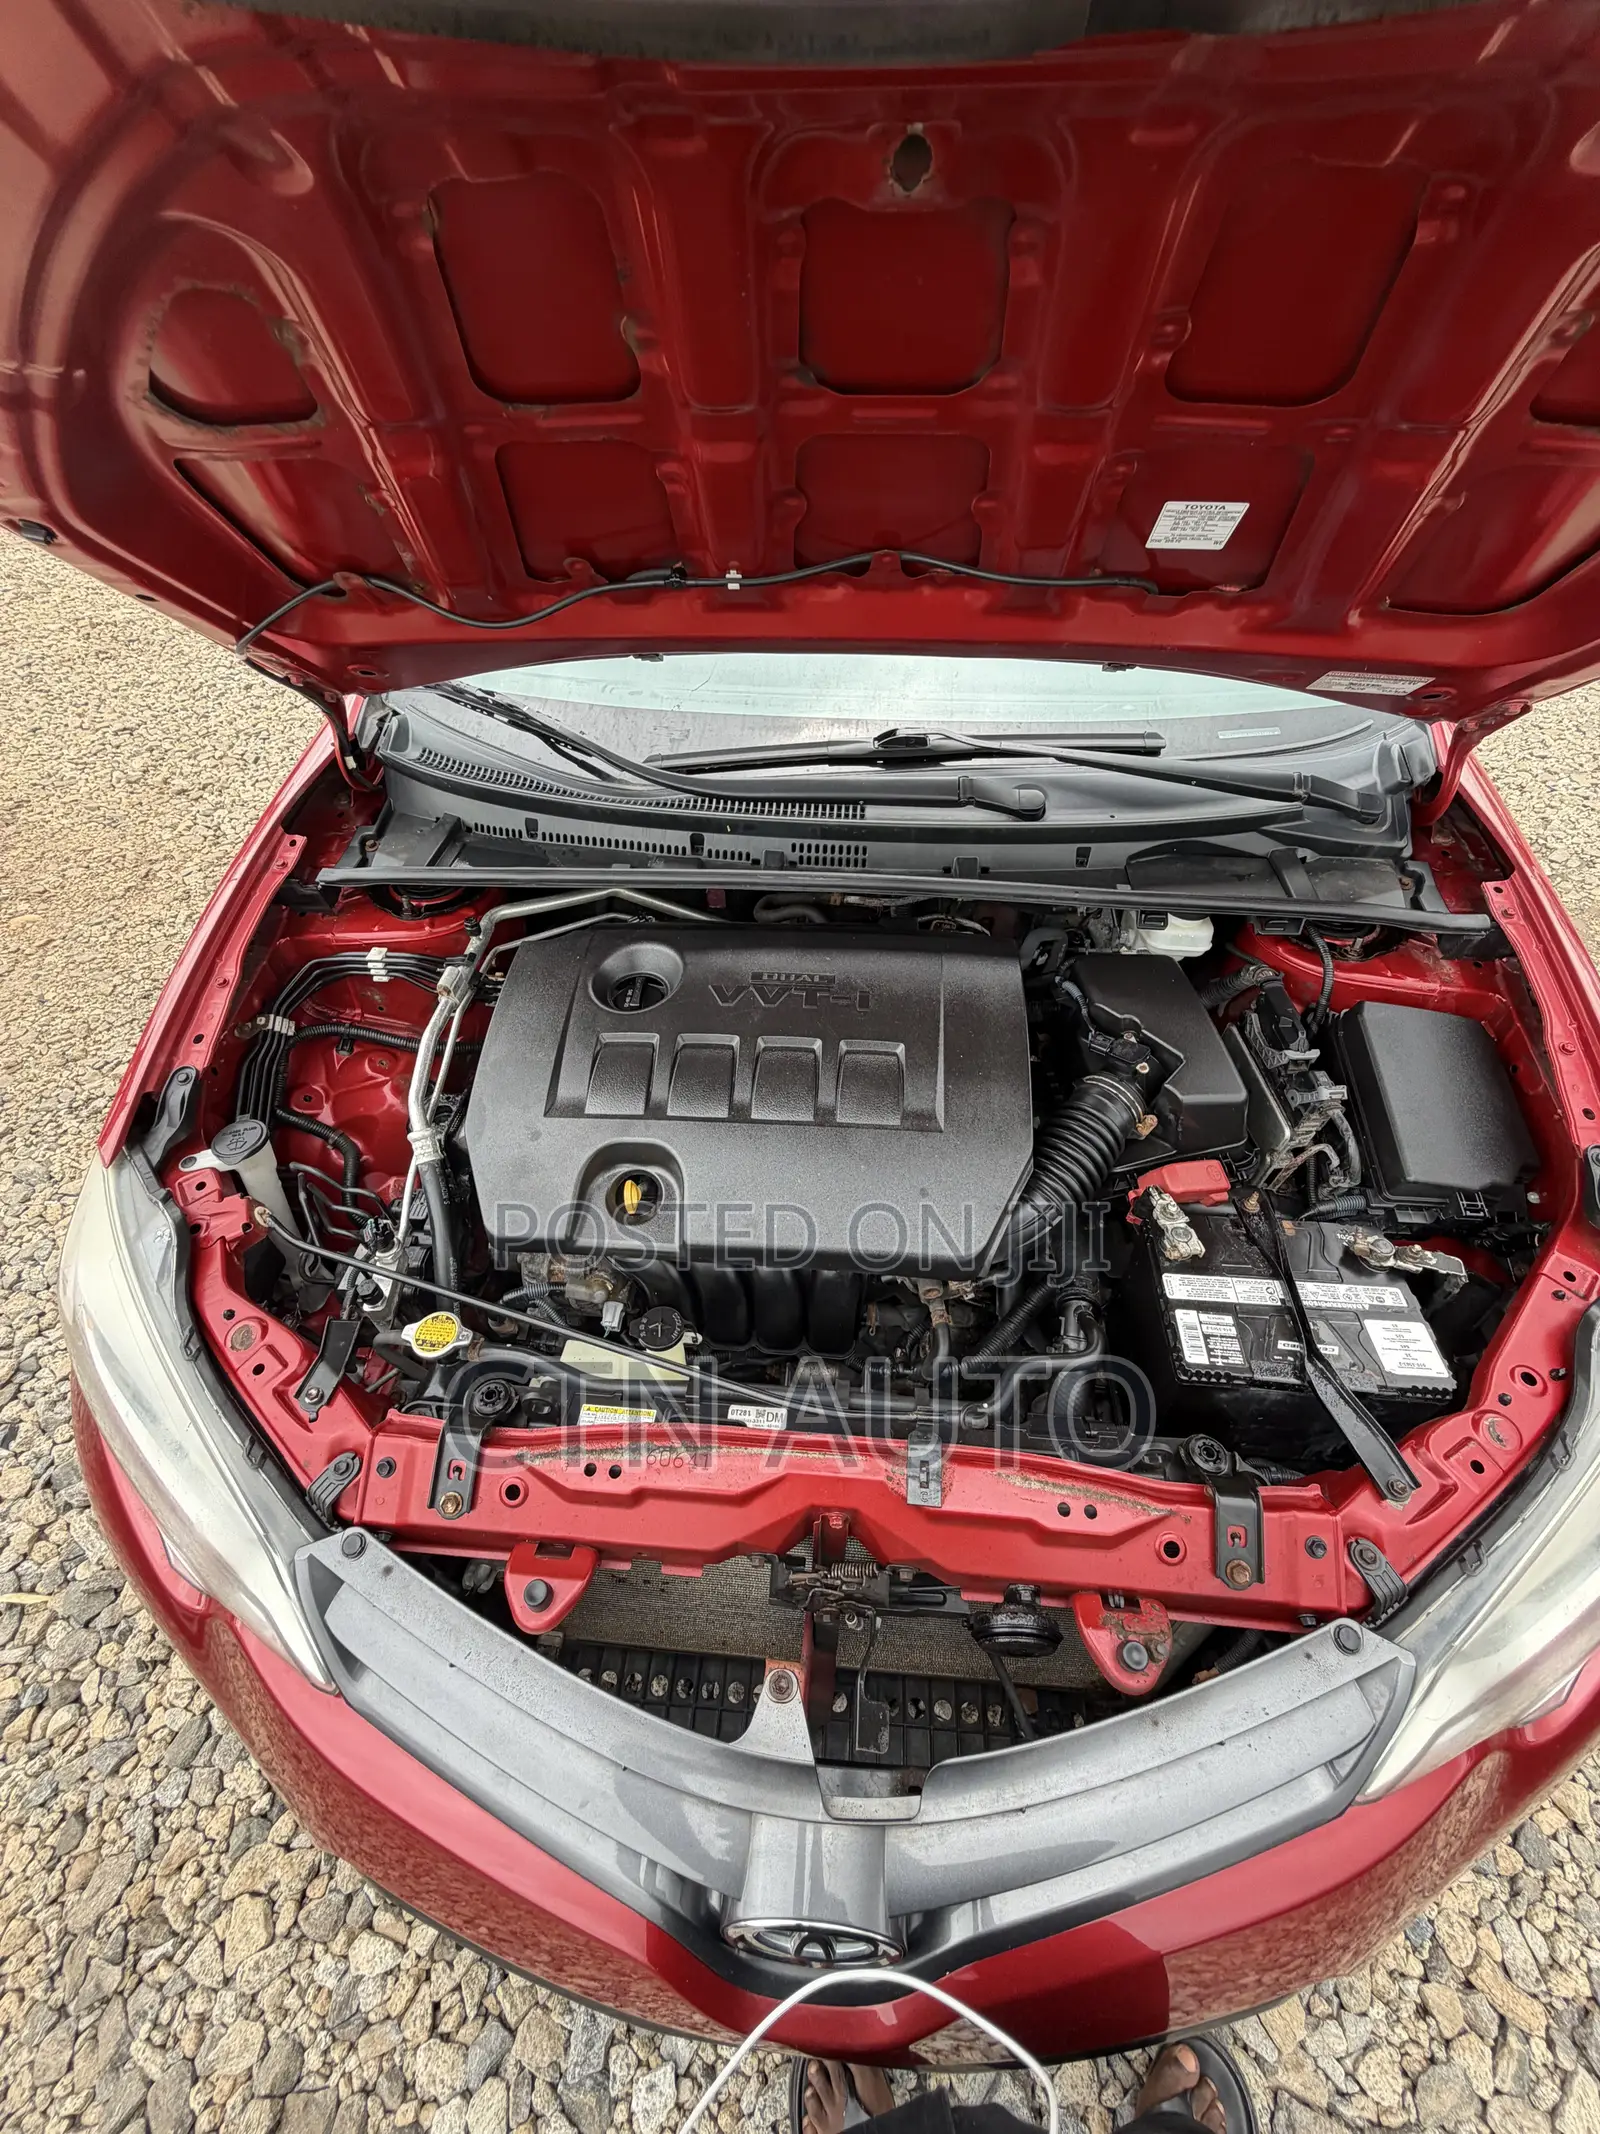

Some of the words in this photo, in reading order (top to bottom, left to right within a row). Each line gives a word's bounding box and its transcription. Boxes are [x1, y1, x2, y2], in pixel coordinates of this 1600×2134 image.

[762, 973, 829, 983] DUAL
[594, 1406, 618, 1414] CAUTION
[622, 1409, 652, 1417] ATTENTION
[766, 1411, 784, 1424] DM
